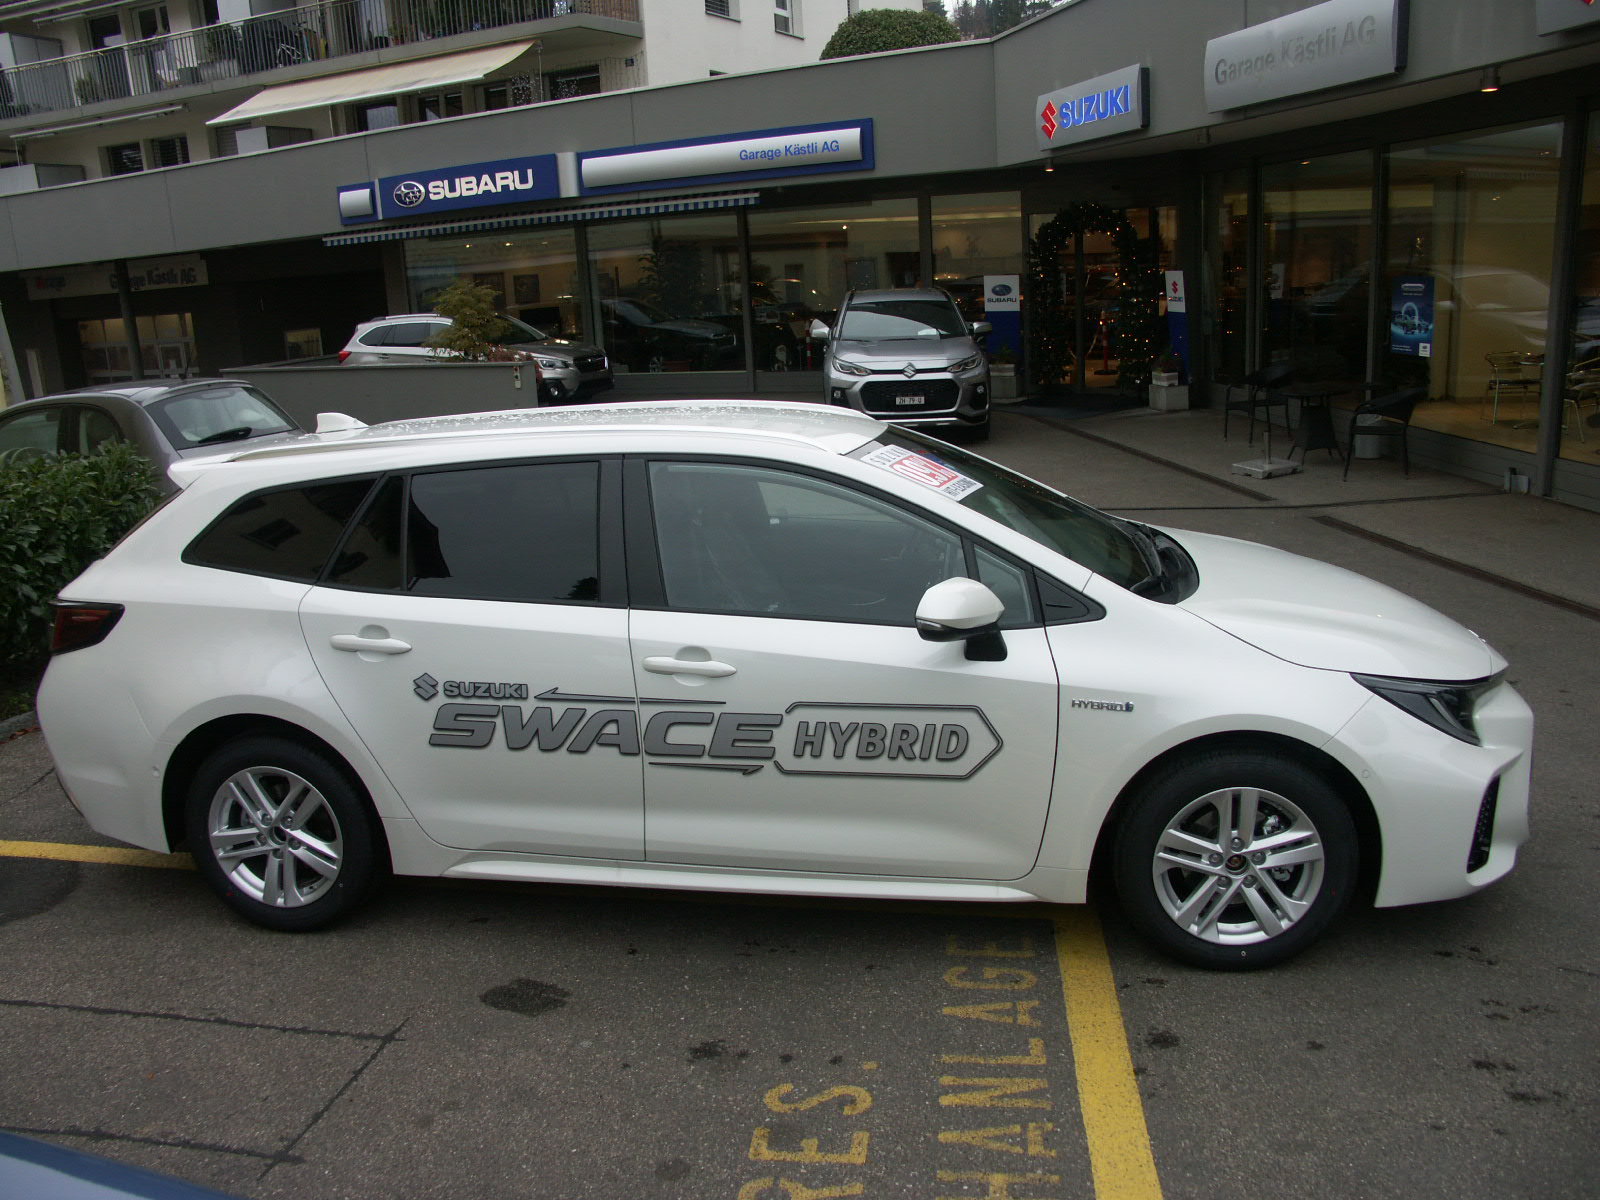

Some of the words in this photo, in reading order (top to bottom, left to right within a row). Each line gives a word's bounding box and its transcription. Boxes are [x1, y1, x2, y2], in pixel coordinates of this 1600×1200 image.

[1214, 51, 1275, 85] Garage
[1280, 26, 1337, 64] Kästli
[1341, 15, 1377, 53] AG
[1060, 85, 1130, 129] SUZUKI
[739, 149, 781, 160] Garage
[784, 142, 818, 157] Kästli
[821, 140, 840, 153] AG
[428, 168, 534, 201] SUBARU
[443, 680, 529, 699] SUZUKI
[1071, 699, 1124, 712] HYBRID
[428, 703, 784, 759] SWACE
[793, 721, 969, 760] HYBRID
